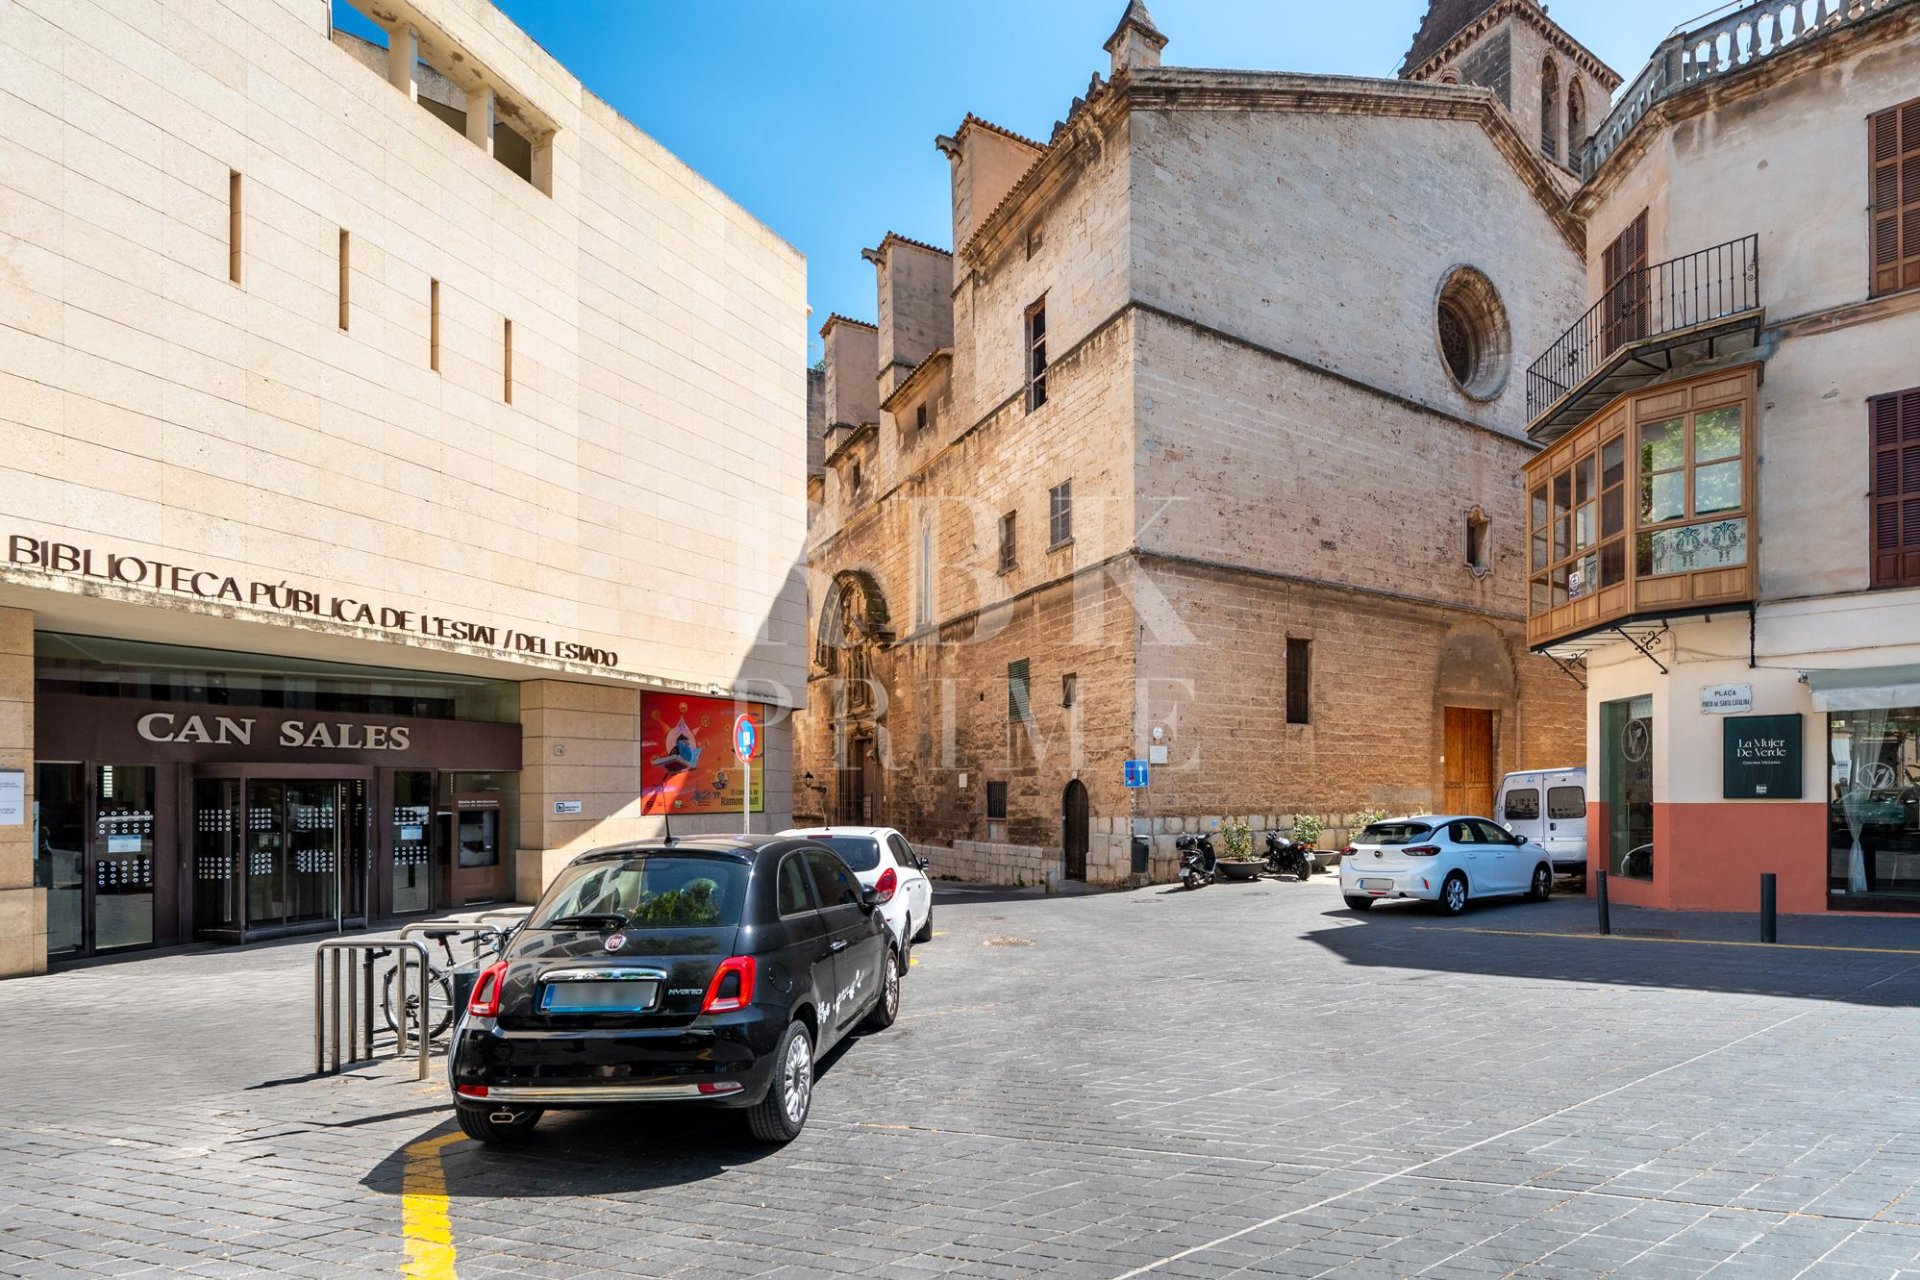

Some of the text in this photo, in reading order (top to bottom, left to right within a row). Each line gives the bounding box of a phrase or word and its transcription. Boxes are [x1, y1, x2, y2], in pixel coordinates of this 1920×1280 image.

[9, 534, 243, 601] BIBLIOTECA
[250, 580, 374, 625] PÚBLICA
[380, 607, 415, 631] DE
[421, 615, 499, 646] L'ESTAT
[515, 633, 551, 656] DEL
[555, 641, 618, 668] ESTADO
[1714, 690, 1737, 698] PLAÇA
[137, 713, 411, 751] CAN SALES
[1738, 738, 1785, 749] La Mujer
[1737, 748, 1787, 757] De Verde
